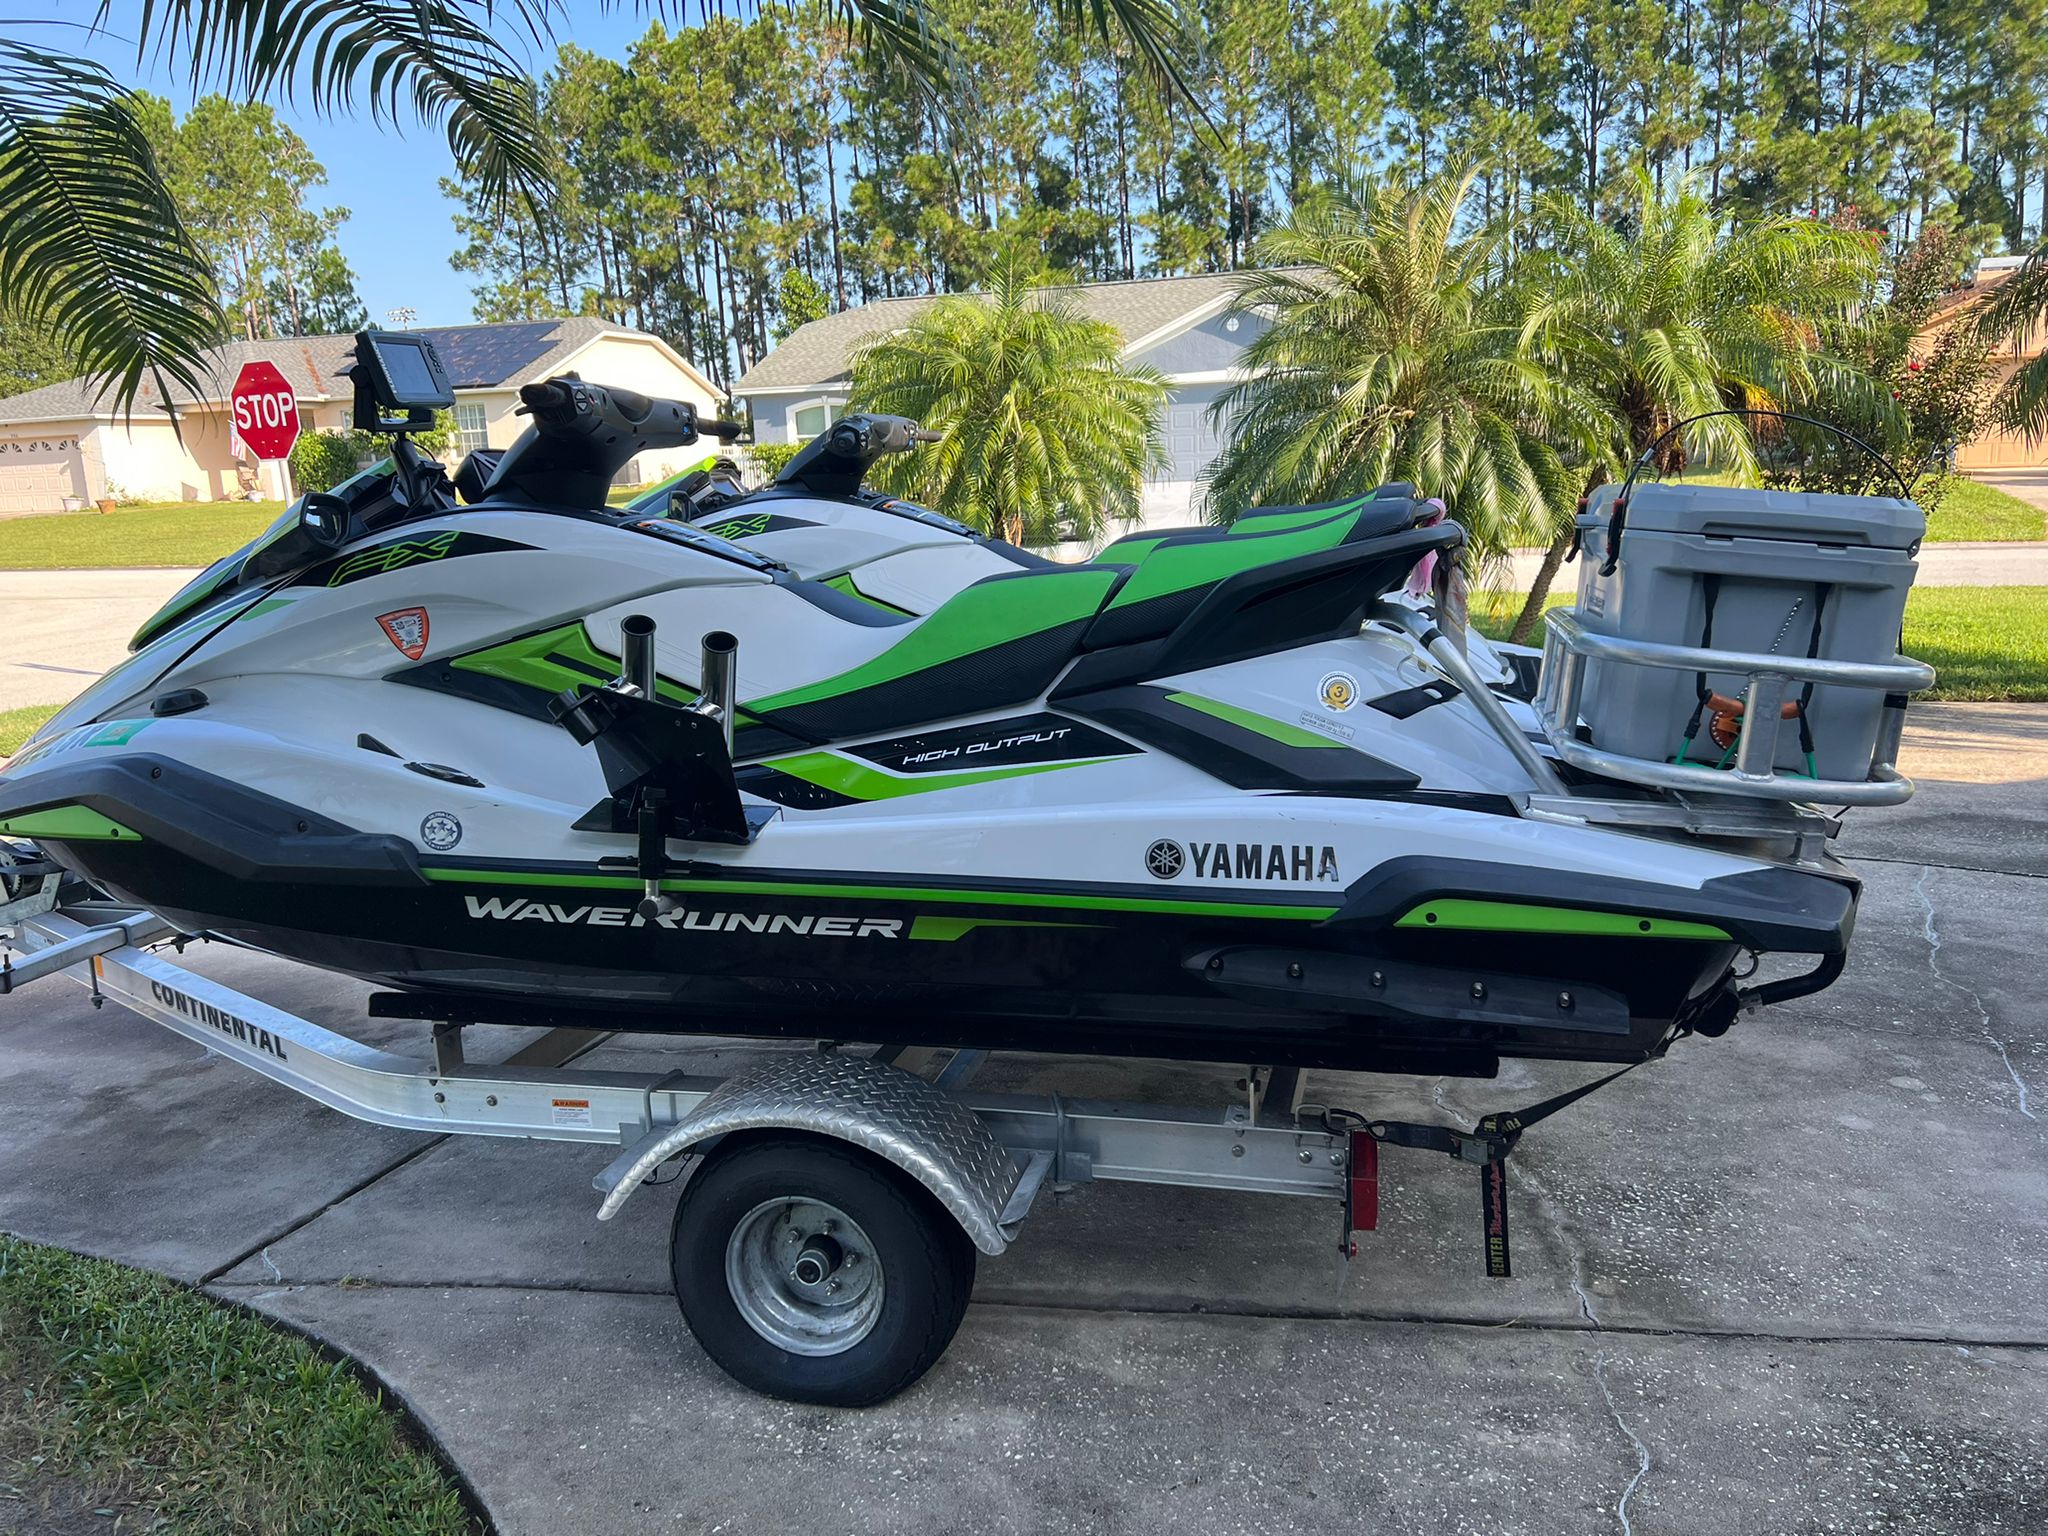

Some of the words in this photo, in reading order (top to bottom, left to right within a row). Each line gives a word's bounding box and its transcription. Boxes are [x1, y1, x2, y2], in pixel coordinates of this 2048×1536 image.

[235, 392, 294, 430] STOP
[326, 530, 462, 588] FX
[1333, 686, 1345, 698] 3
[902, 747, 961, 765] HIGH
[965, 728, 1072, 754] OUTPUT
[1189, 842, 1340, 882] YAMAHA
[151, 980, 288, 1063] CONTINENTAL
[1490, 1236, 1505, 1275] CENTER
